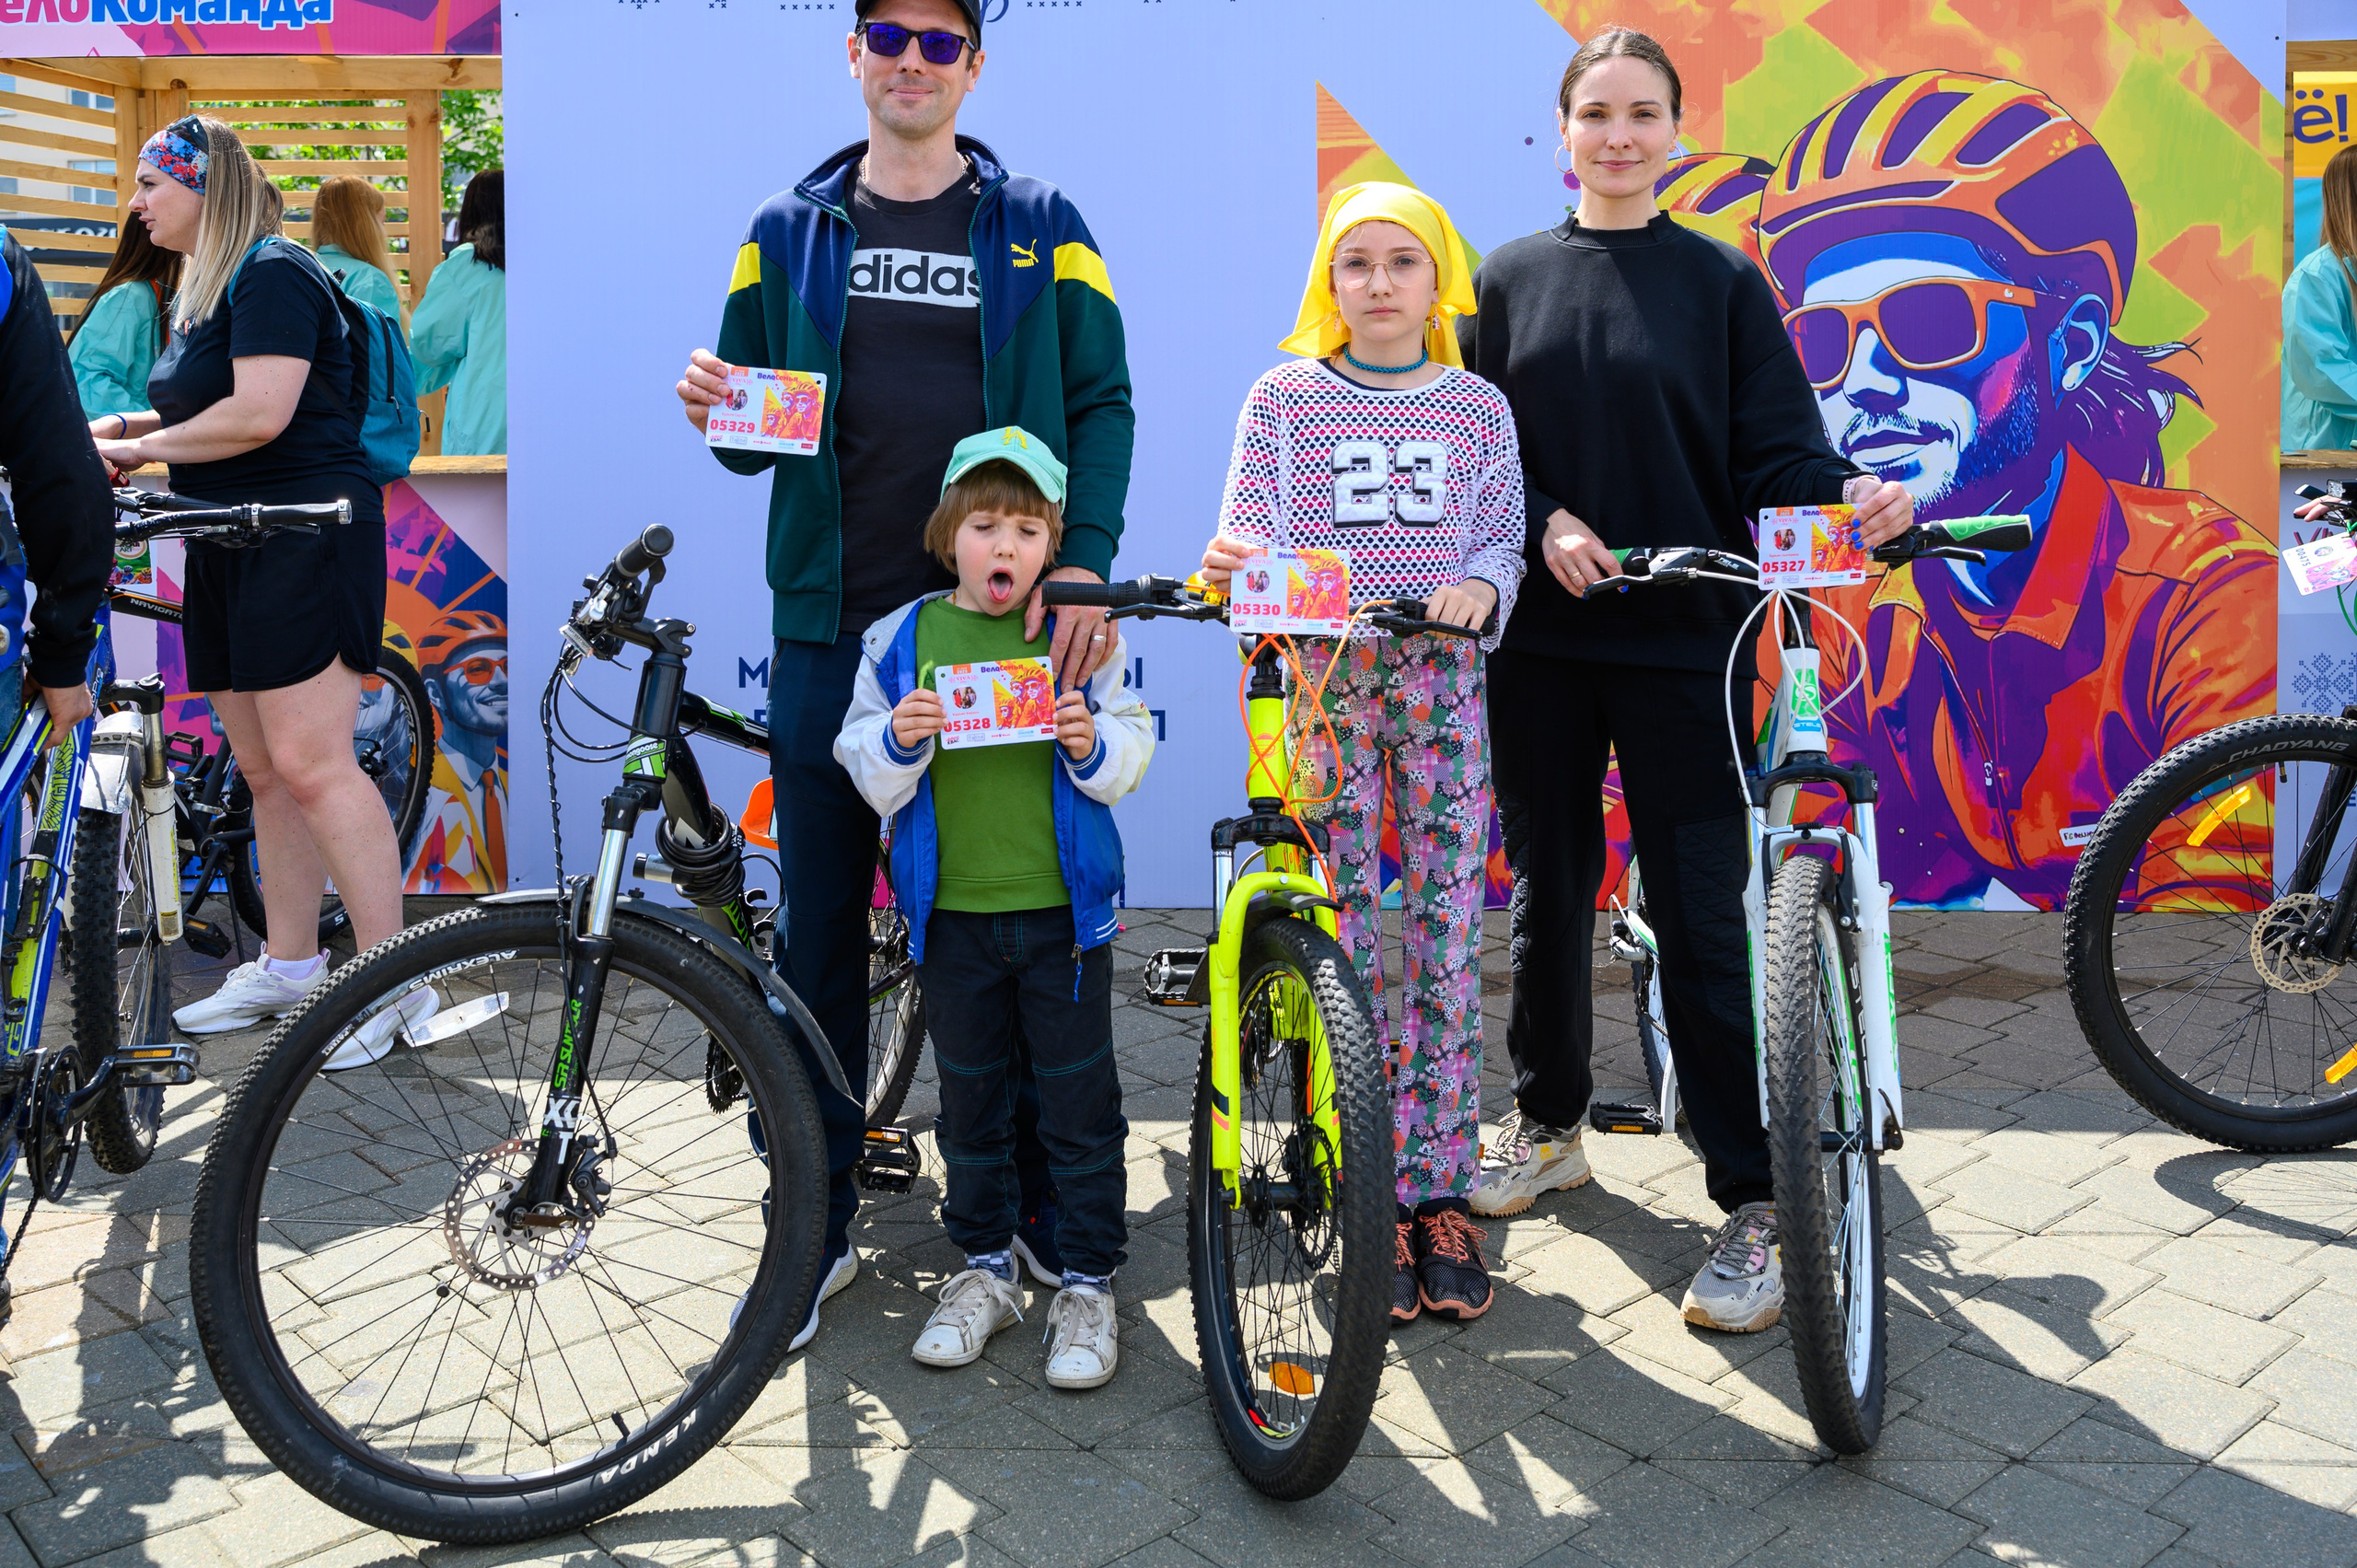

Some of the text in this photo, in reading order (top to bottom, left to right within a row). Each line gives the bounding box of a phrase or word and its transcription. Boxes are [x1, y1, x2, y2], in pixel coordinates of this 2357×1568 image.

[1012, 258, 1035, 268] PUMA
[710, 419, 755, 434] 05329
[1330, 441, 1448, 529] 23
[1762, 560, 1805, 573] 05327
[2295, 548, 2311, 567] 00475
[1232, 603, 1281, 616] 05330
[944, 717, 991, 733] 05328
[2228, 739, 2350, 763] CHAOYANG
[408, 949, 518, 992] ALEXRIMS
[563, 999, 583, 1064] SUNTUR
[600, 1409, 697, 1484] KENDA
